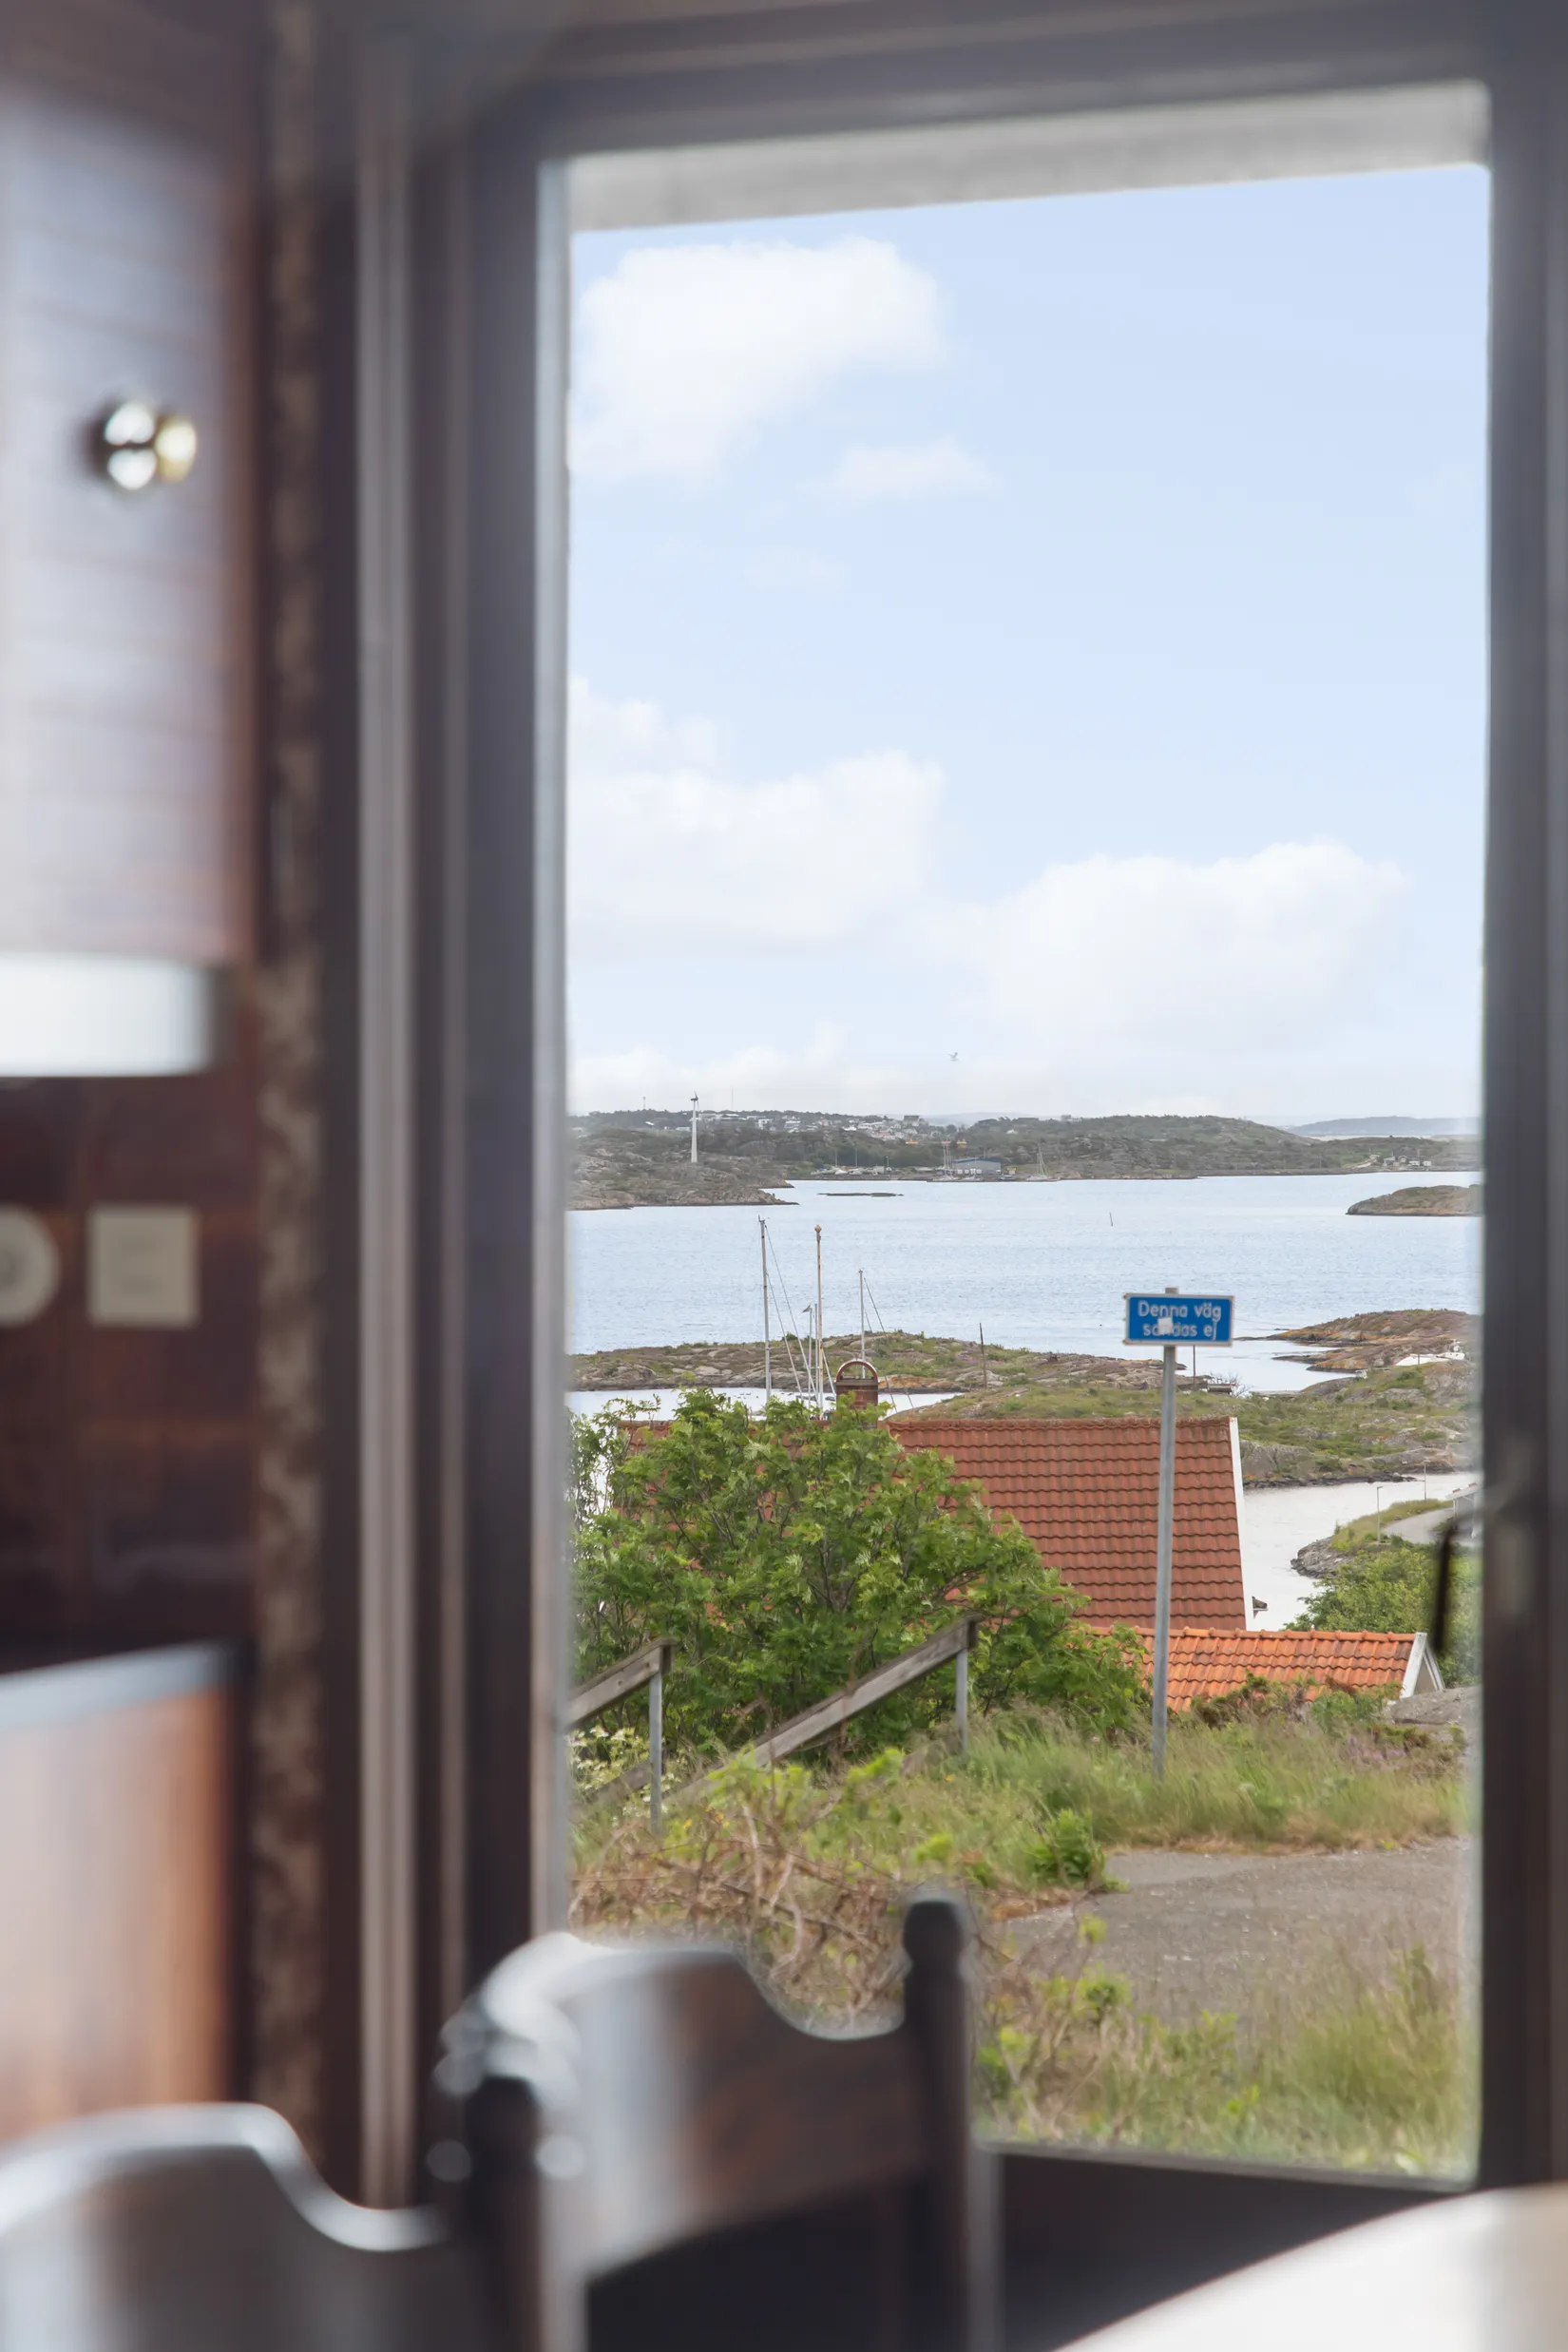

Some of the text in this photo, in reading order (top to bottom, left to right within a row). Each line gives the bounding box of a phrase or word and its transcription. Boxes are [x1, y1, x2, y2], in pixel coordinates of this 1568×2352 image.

[1138, 1300, 1222, 1323] Denna väg
[1142, 1322, 1217, 1341] sadas ej
